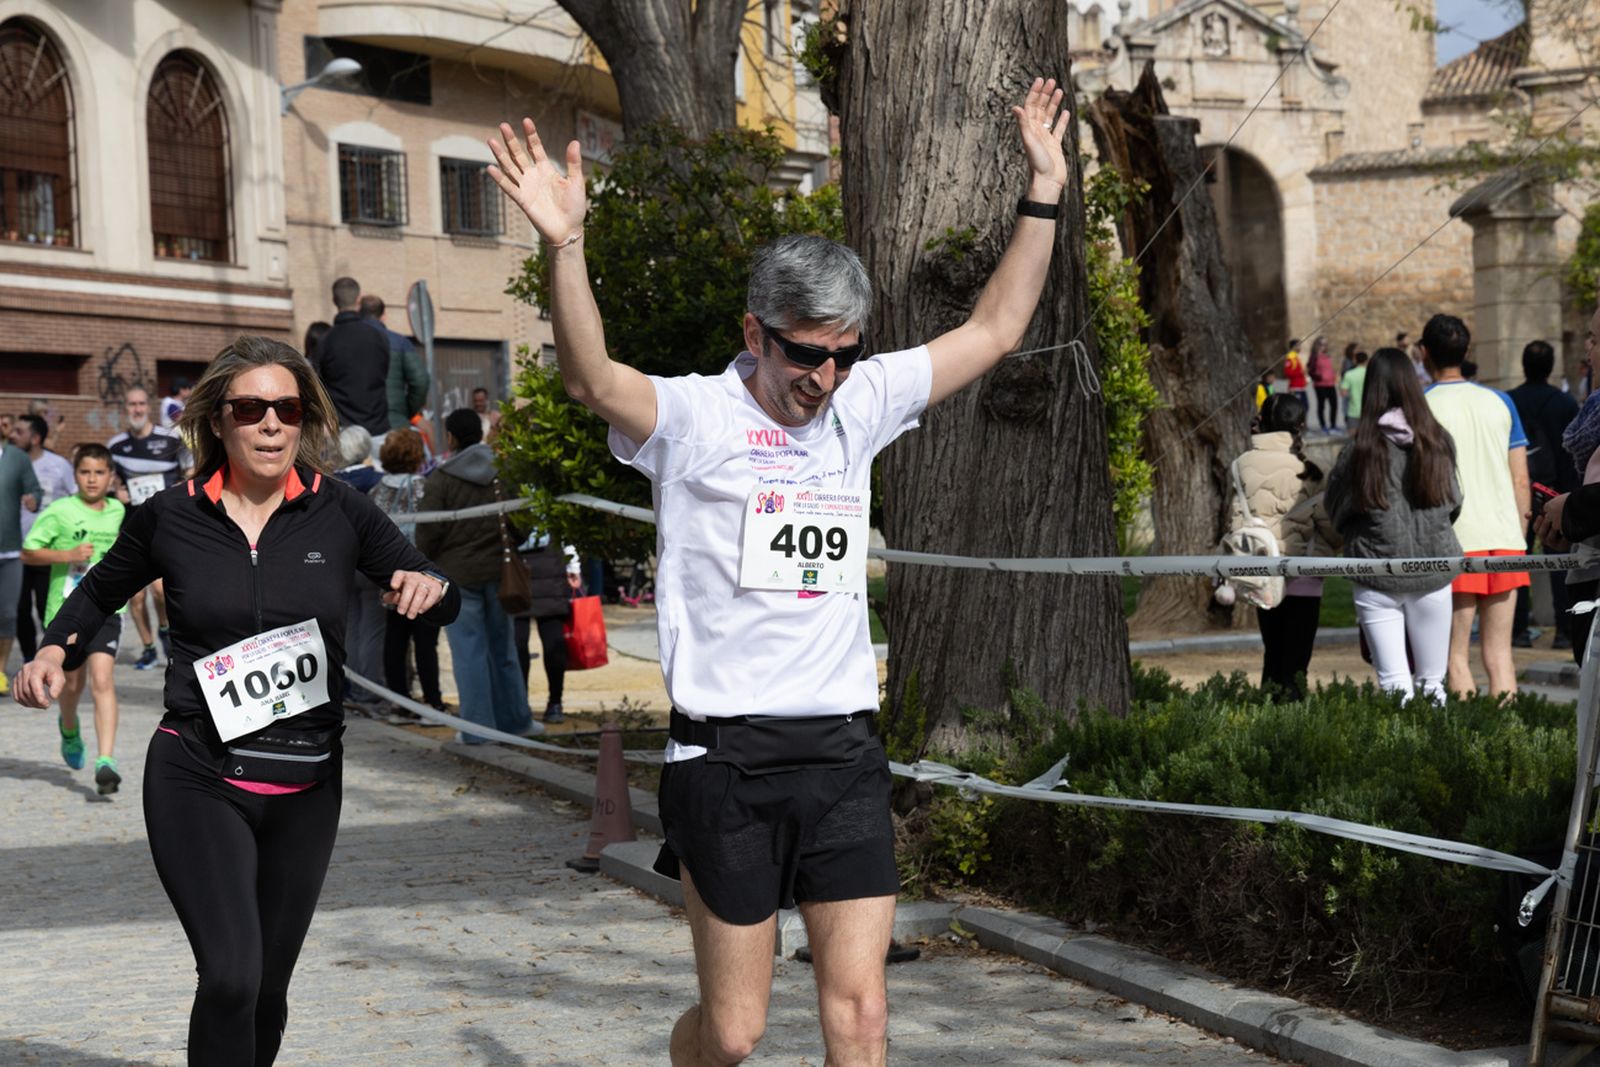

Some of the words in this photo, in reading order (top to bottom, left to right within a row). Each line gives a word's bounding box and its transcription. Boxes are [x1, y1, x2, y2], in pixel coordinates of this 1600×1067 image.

[814, 493, 837, 502] CARRERA
[837, 494, 861, 503] POPULAR
[770, 524, 848, 561] 409
[1228, 566, 1271, 576] DEPORTES
[1401, 560, 1451, 573] DEPORTES
[1484, 559, 1543, 572] Ayuntamiento
[1544, 558, 1556, 570] de
[1558, 556, 1580, 569] Jaén
[280, 627, 305, 639] POPULAR
[219, 653, 318, 708] 1060
